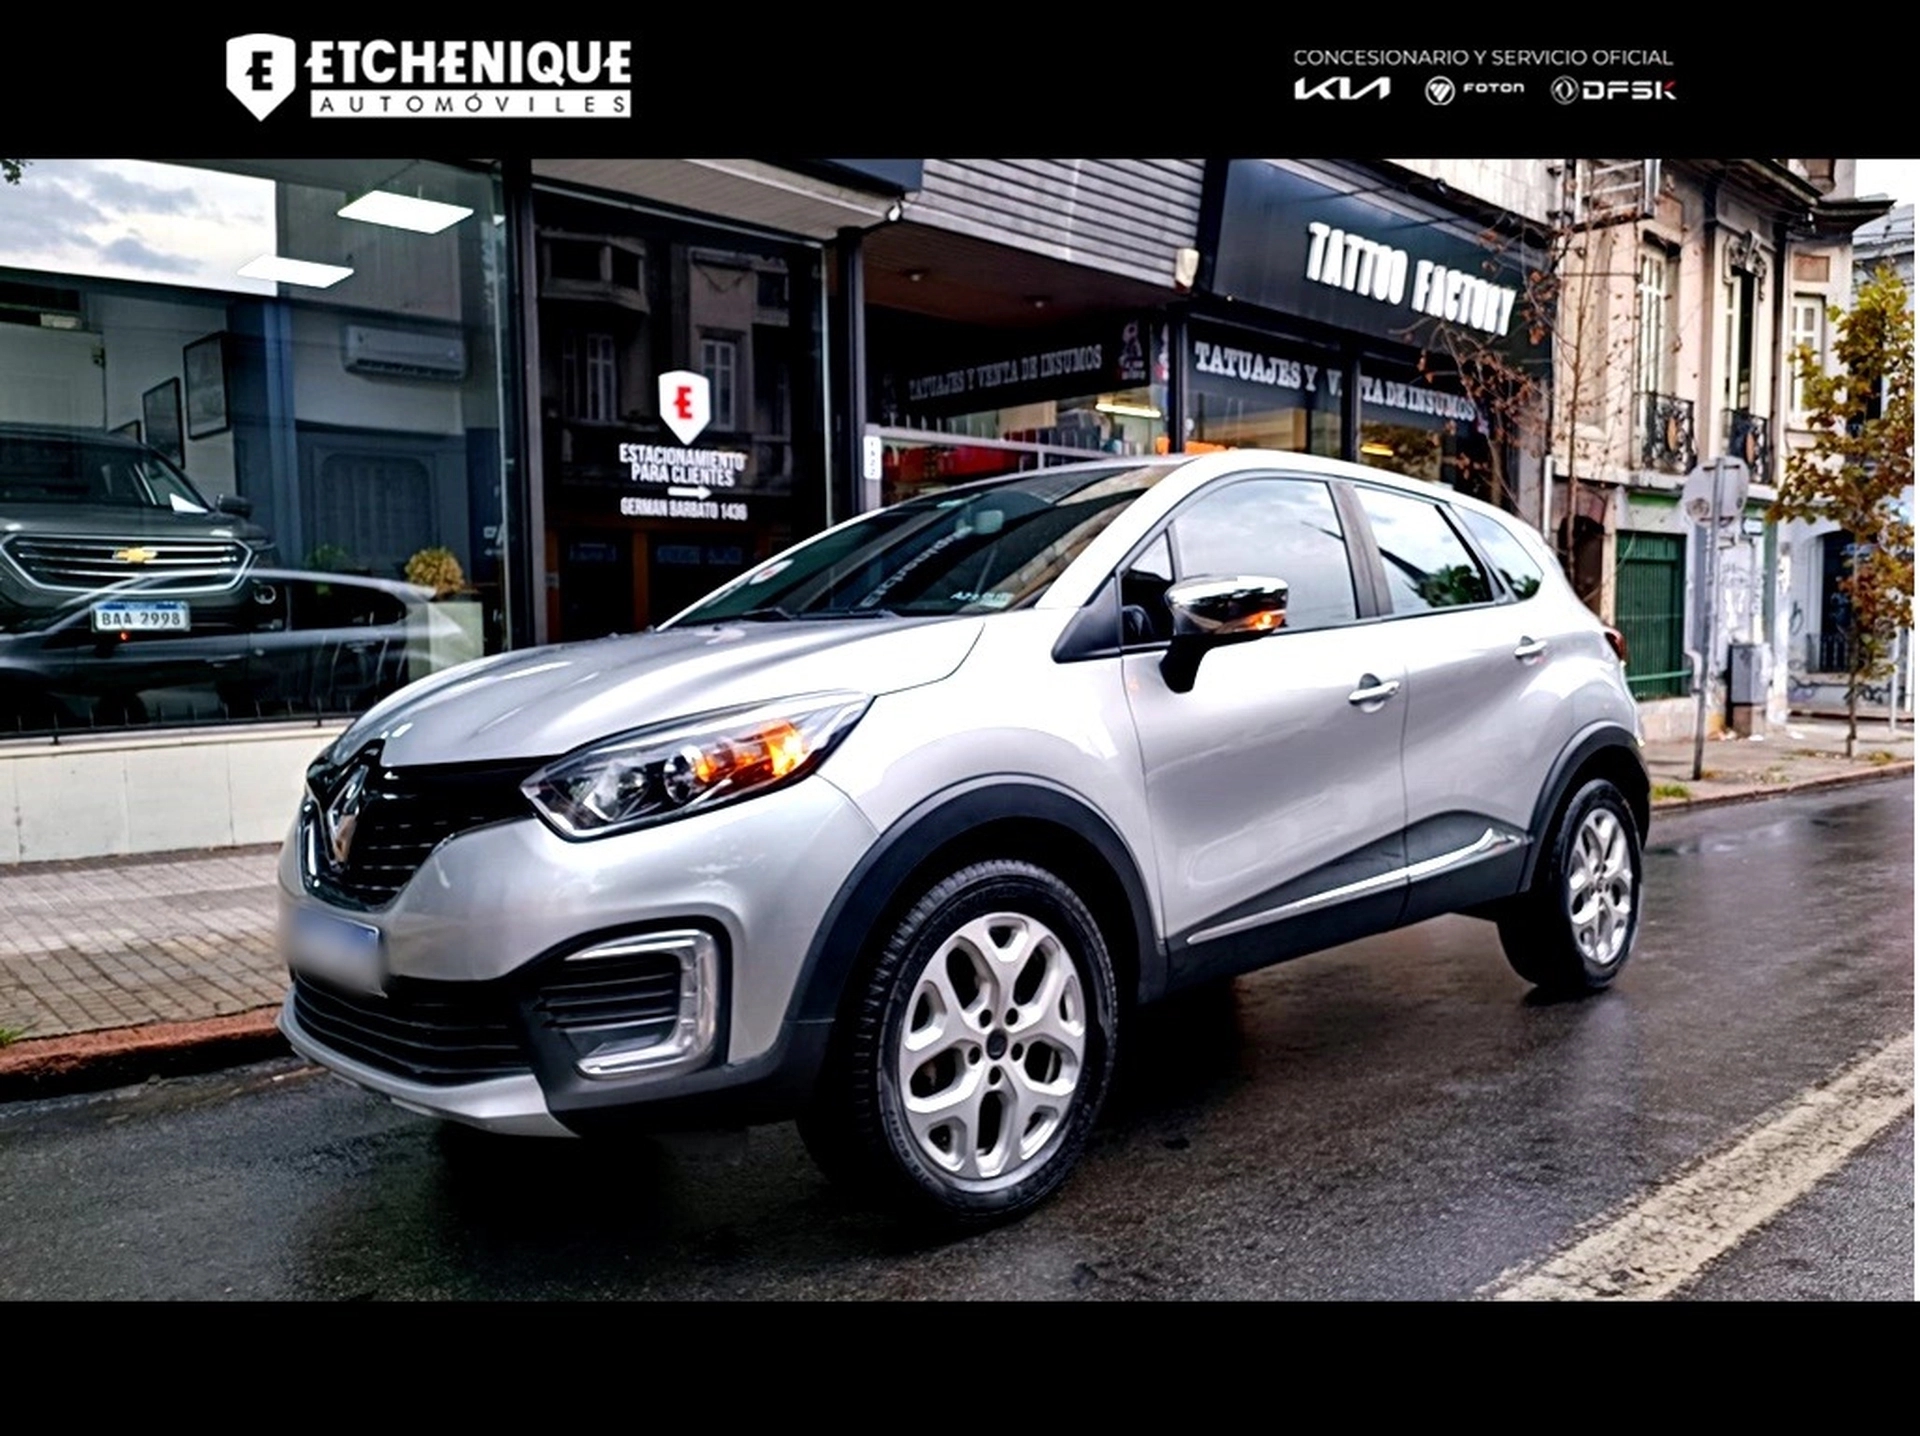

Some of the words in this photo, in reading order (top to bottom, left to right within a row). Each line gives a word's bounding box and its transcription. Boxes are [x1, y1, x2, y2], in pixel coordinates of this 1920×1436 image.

[1306, 221, 1409, 305] TATTOO
[1411, 259, 1517, 337] FACTORY
[1194, 340, 1302, 390] TATUAJES
[1303, 364, 1319, 392] Y
[618, 442, 748, 472] ESTACIONAMIENTO
[631, 462, 670, 484] PARA
[670, 466, 736, 488] CLIENTES
[101, 612, 133, 626] BAA
